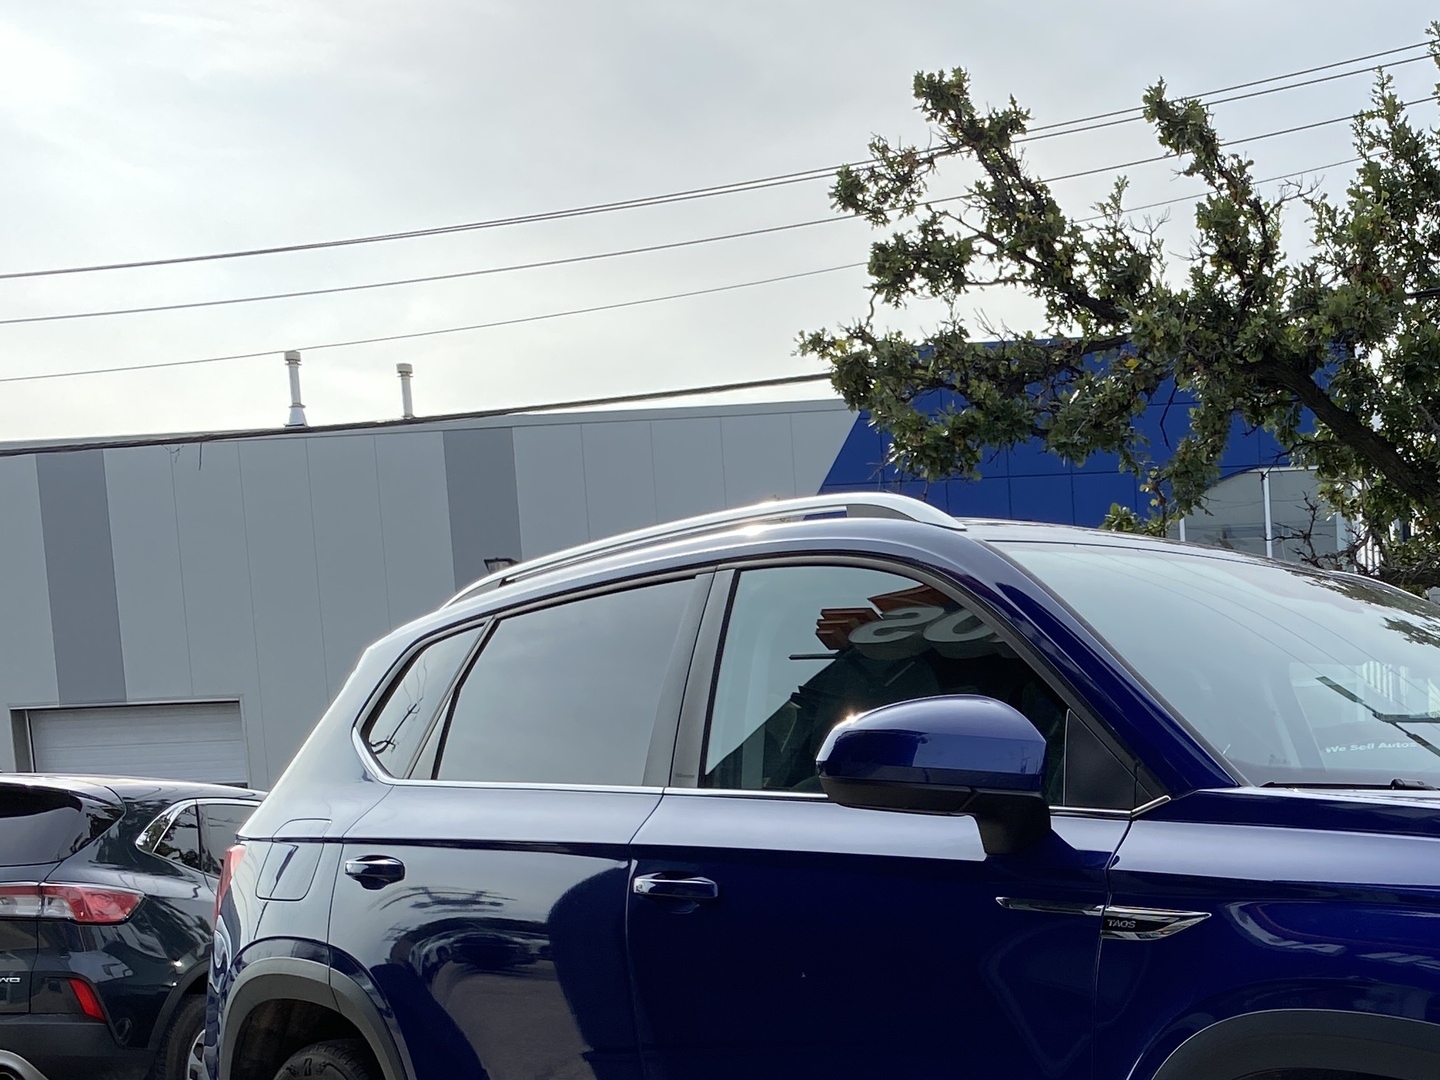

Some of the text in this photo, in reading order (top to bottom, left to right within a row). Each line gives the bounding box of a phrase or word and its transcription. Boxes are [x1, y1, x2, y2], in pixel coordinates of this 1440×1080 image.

[1325, 741, 1417, 754] We Sell Autos
[1107, 919, 1137, 929] TAOS
